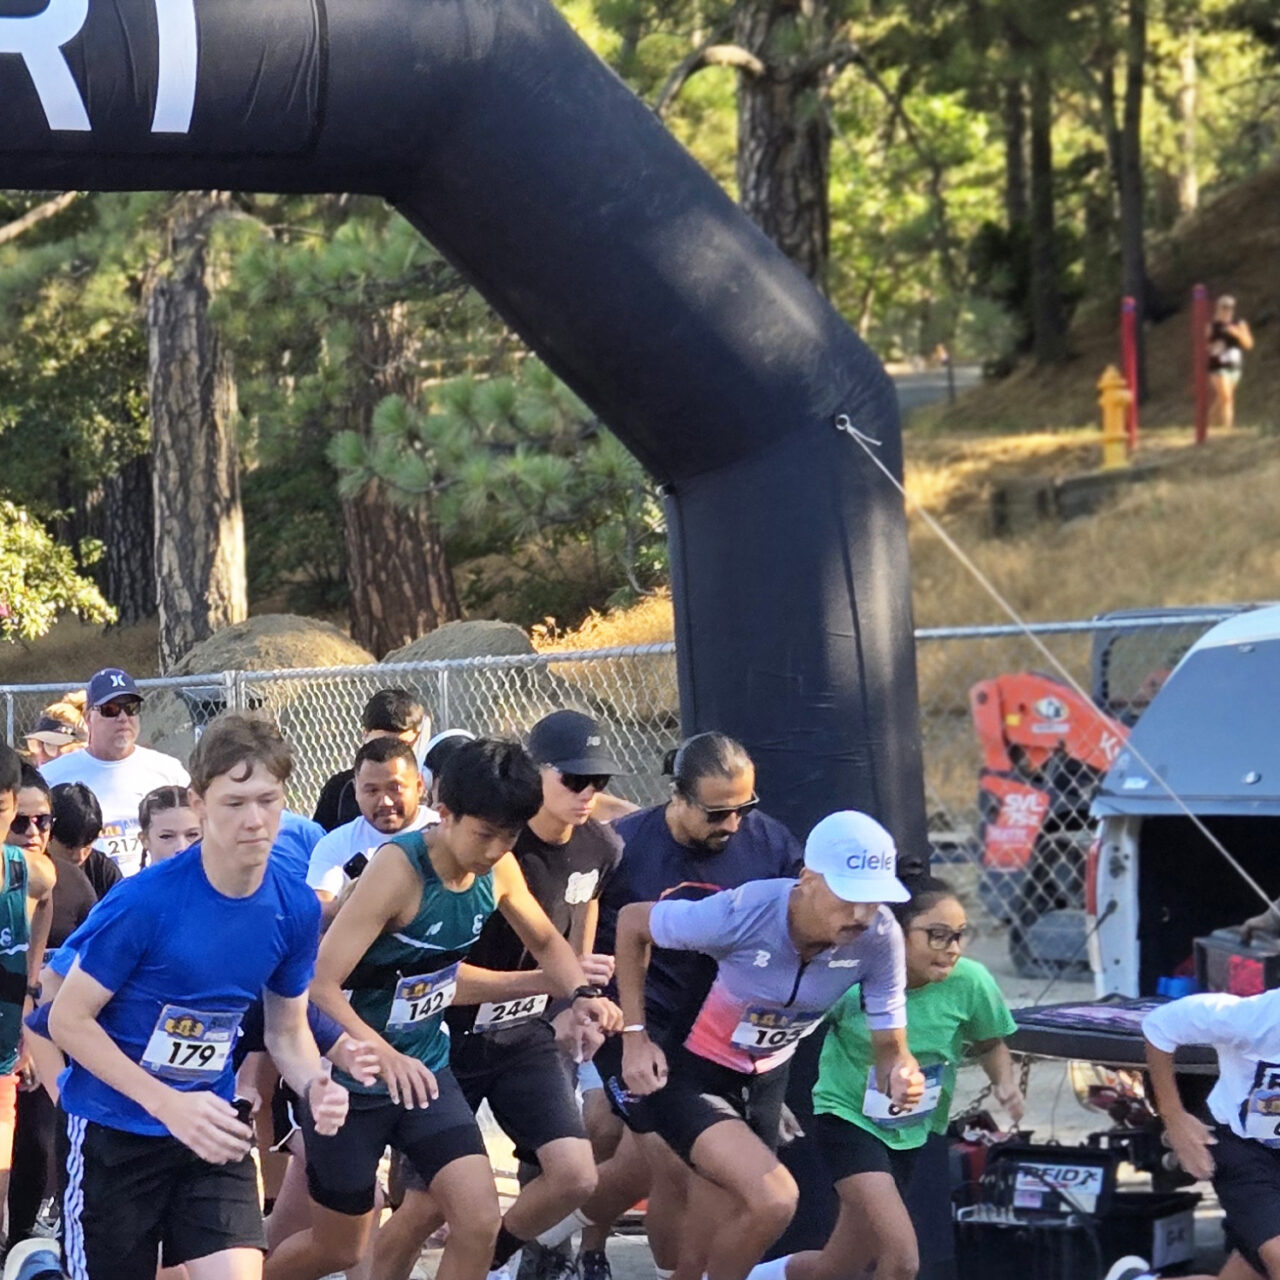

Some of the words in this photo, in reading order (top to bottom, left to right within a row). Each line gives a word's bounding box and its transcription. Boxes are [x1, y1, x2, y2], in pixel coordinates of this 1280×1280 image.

[108, 838, 138, 854] 217
[846, 849, 893, 870] ciele
[410, 992, 444, 1021] 142
[489, 997, 535, 1022] 244
[168, 1041, 216, 1067] 179
